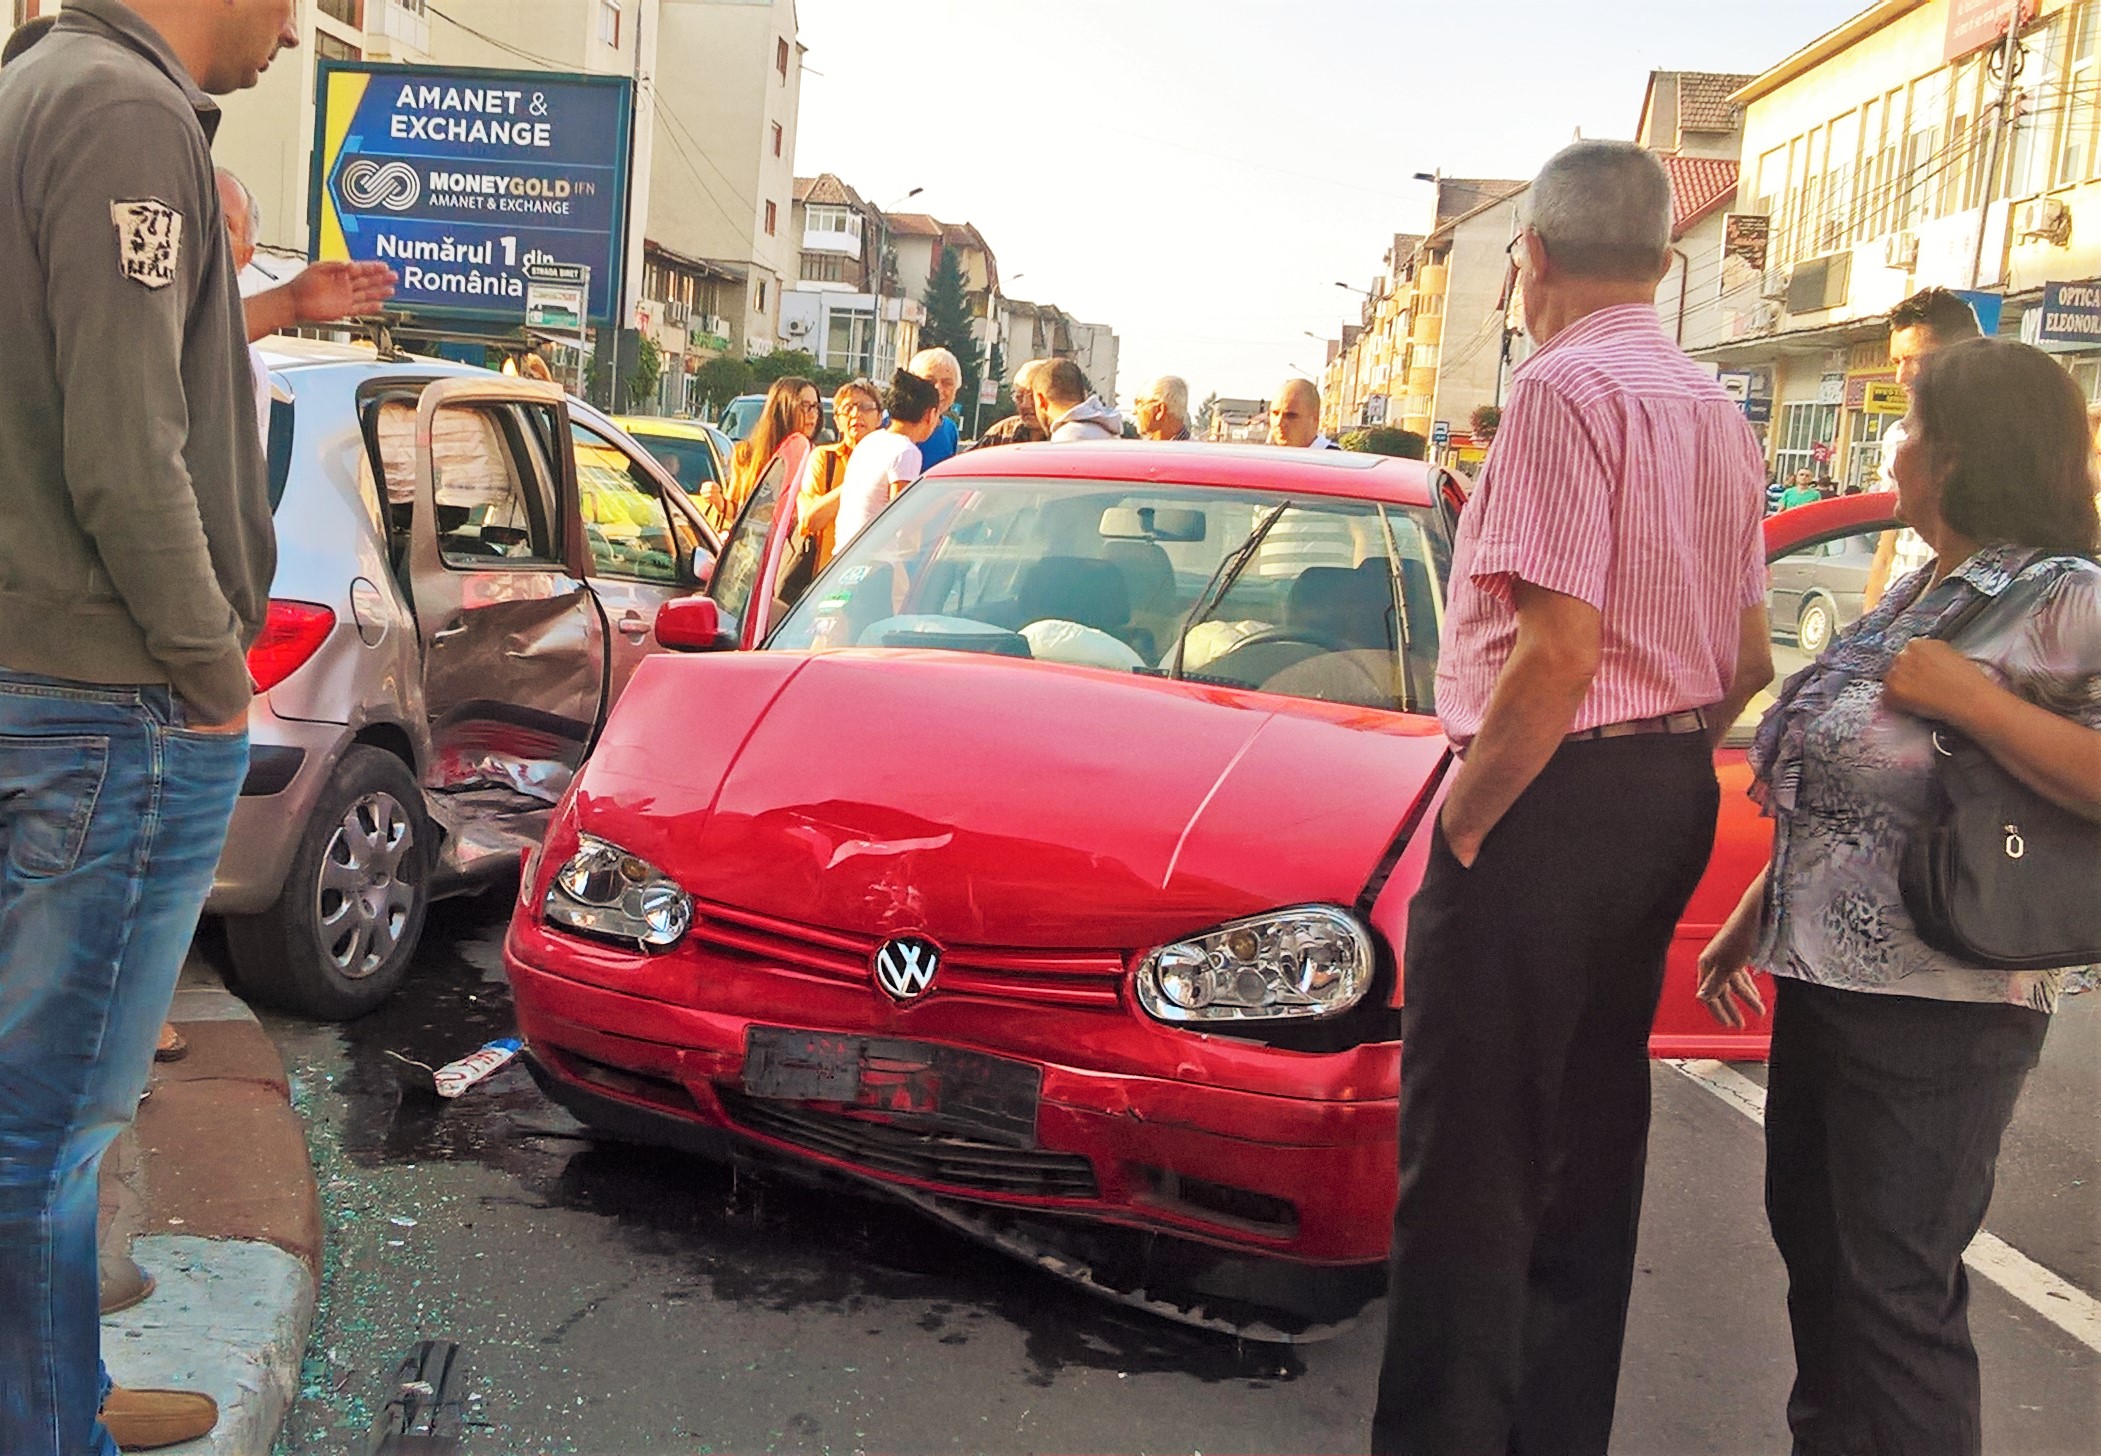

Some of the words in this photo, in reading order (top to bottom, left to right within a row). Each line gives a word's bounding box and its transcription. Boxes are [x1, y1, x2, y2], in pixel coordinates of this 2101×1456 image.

[396, 84, 521, 114] AMANET
[528, 91, 548, 116] &
[390, 114, 551, 147] EXCHANGE
[429, 171, 571, 198] MONEYGOLD
[429, 196, 484, 210] AMANET
[486, 198, 497, 210] &
[499, 197, 570, 215] EXCHANGE
[376, 234, 493, 265] Numărul
[499, 236, 517, 266] 1
[403, 266, 524, 298] România
[2058, 286, 2100, 308] OPTICA
[2045, 312, 2101, 334] ELEONOR
